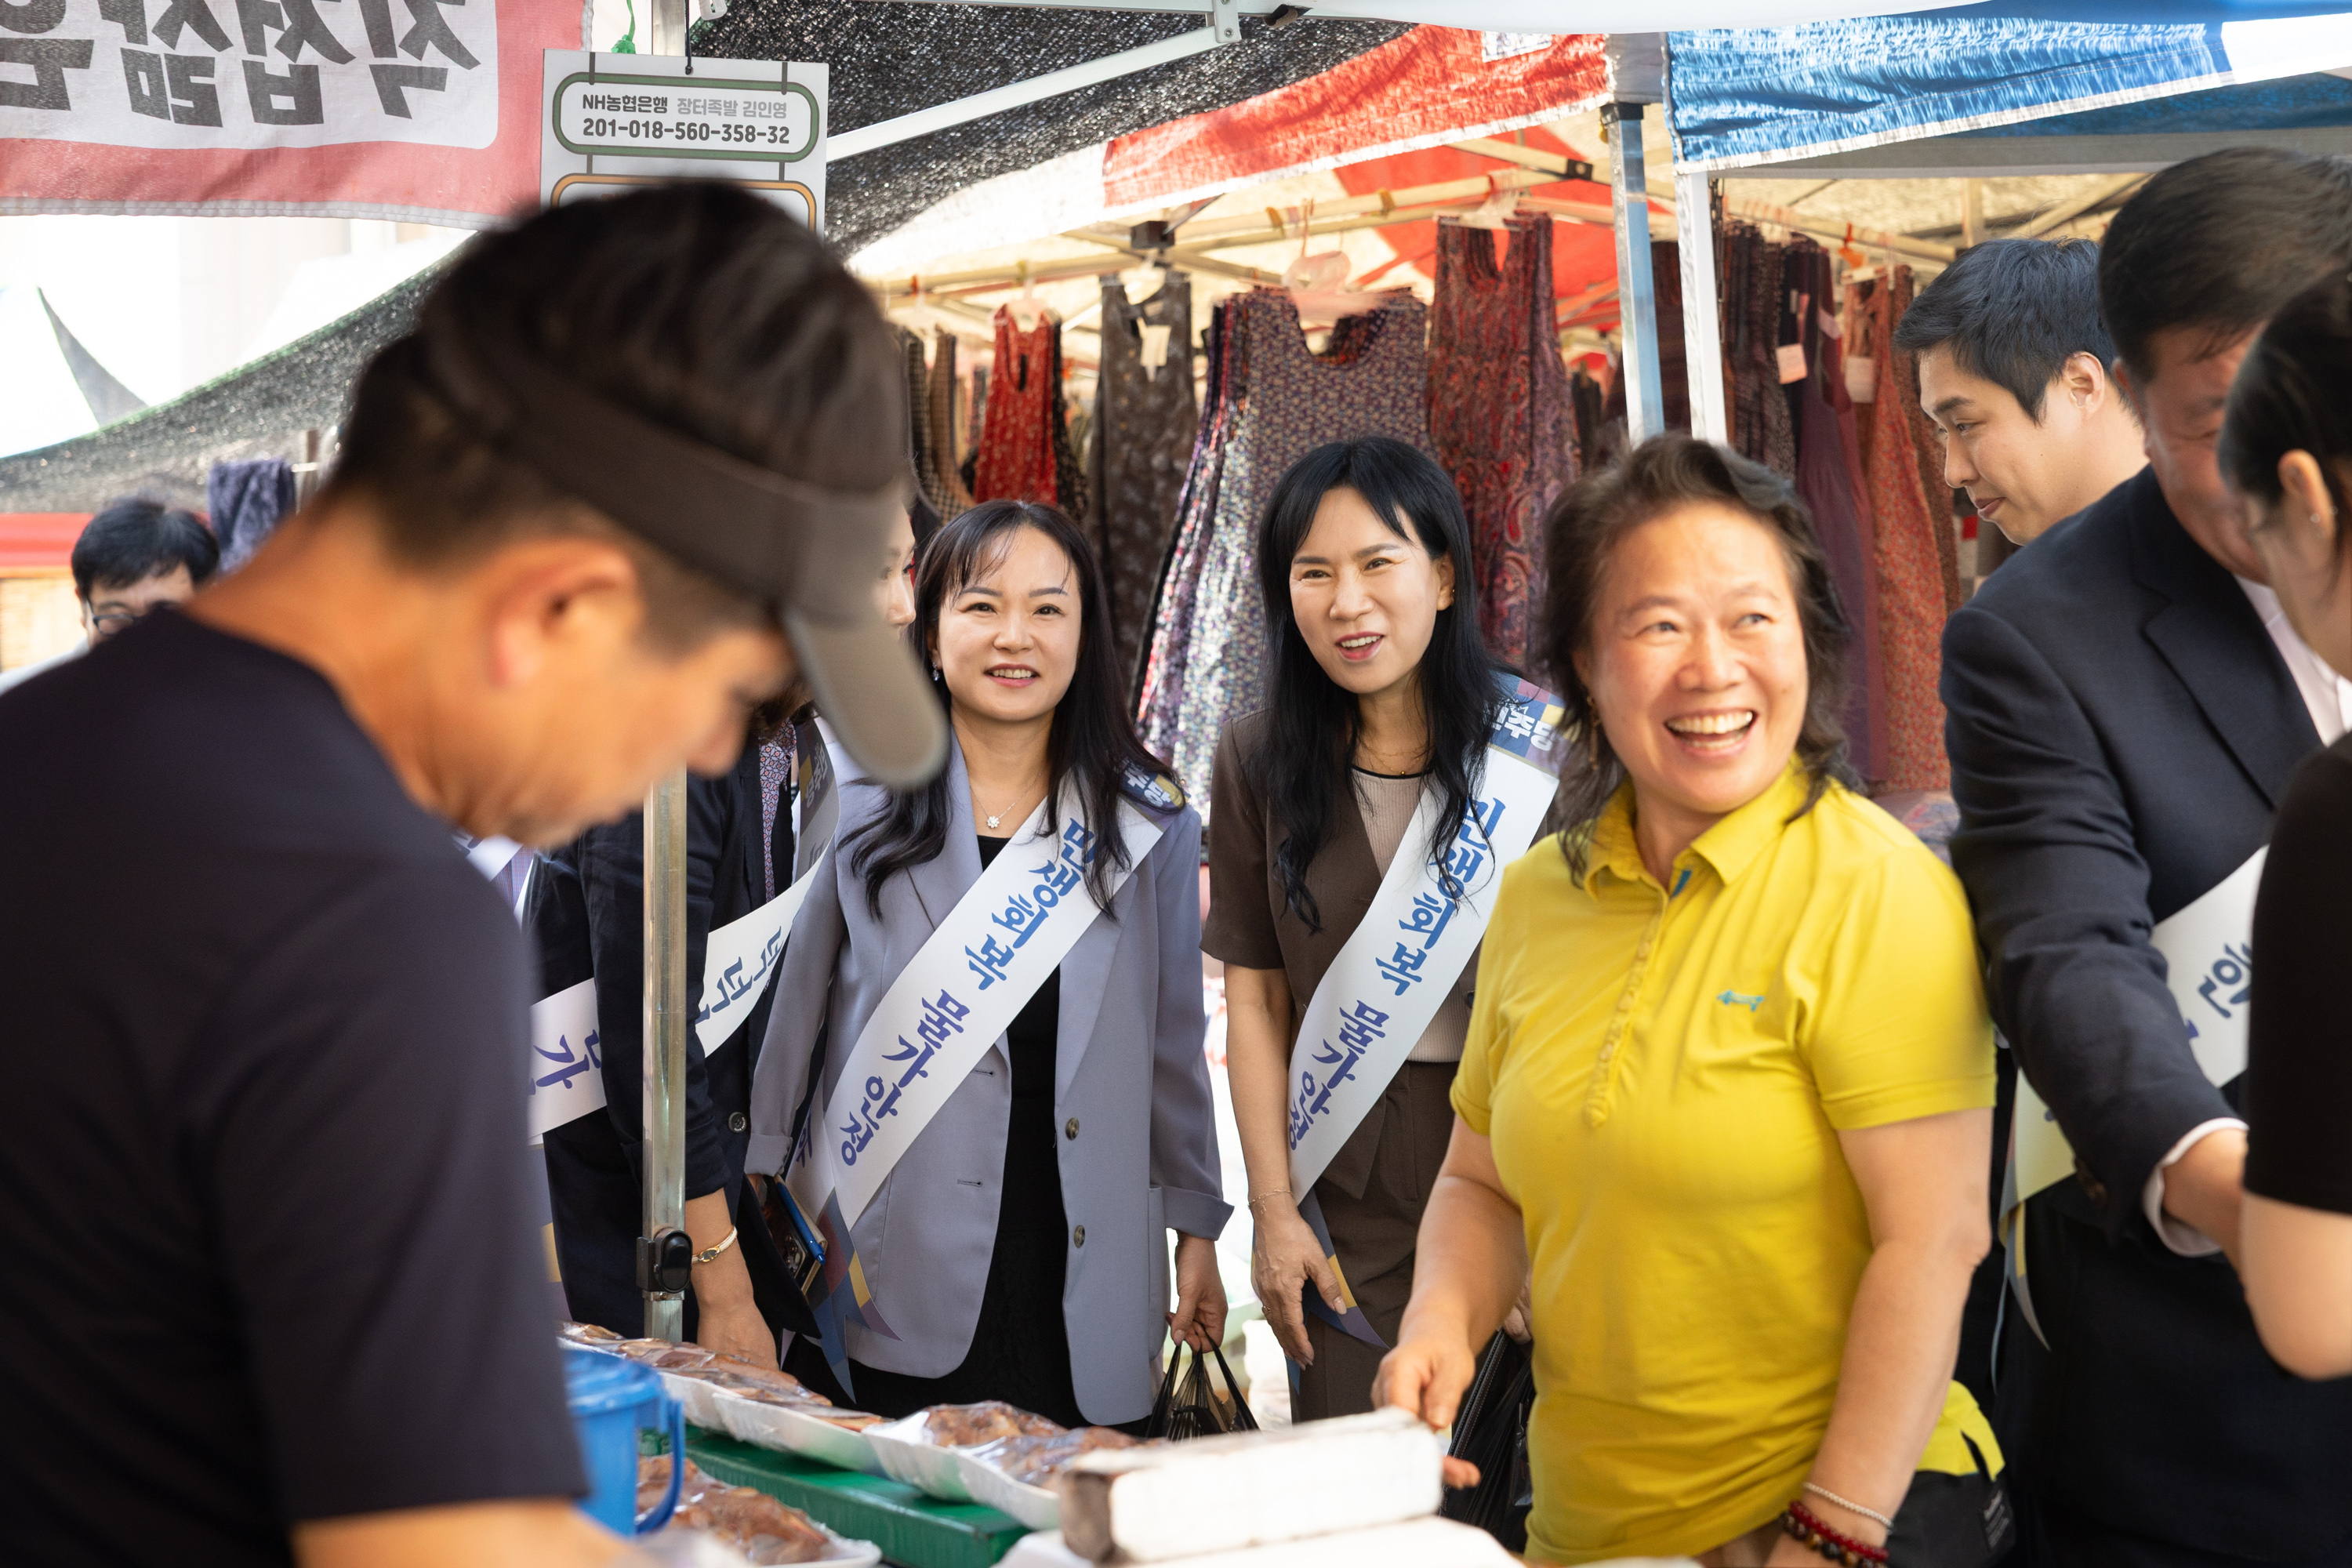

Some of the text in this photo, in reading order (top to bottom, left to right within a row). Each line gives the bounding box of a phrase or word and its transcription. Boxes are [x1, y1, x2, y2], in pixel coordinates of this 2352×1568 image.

[583, 94, 787, 119] NH농협은행 장터족발 김인영
[583, 118, 789, 144] 201-018-560-358-32
[1120, 759, 1172, 808] 주당
[695, 925, 783, 1025] 넉넉
[839, 817, 1098, 1167] 민생회복 물가안정
[1289, 797, 1506, 1151] 민생회복 물가안정
